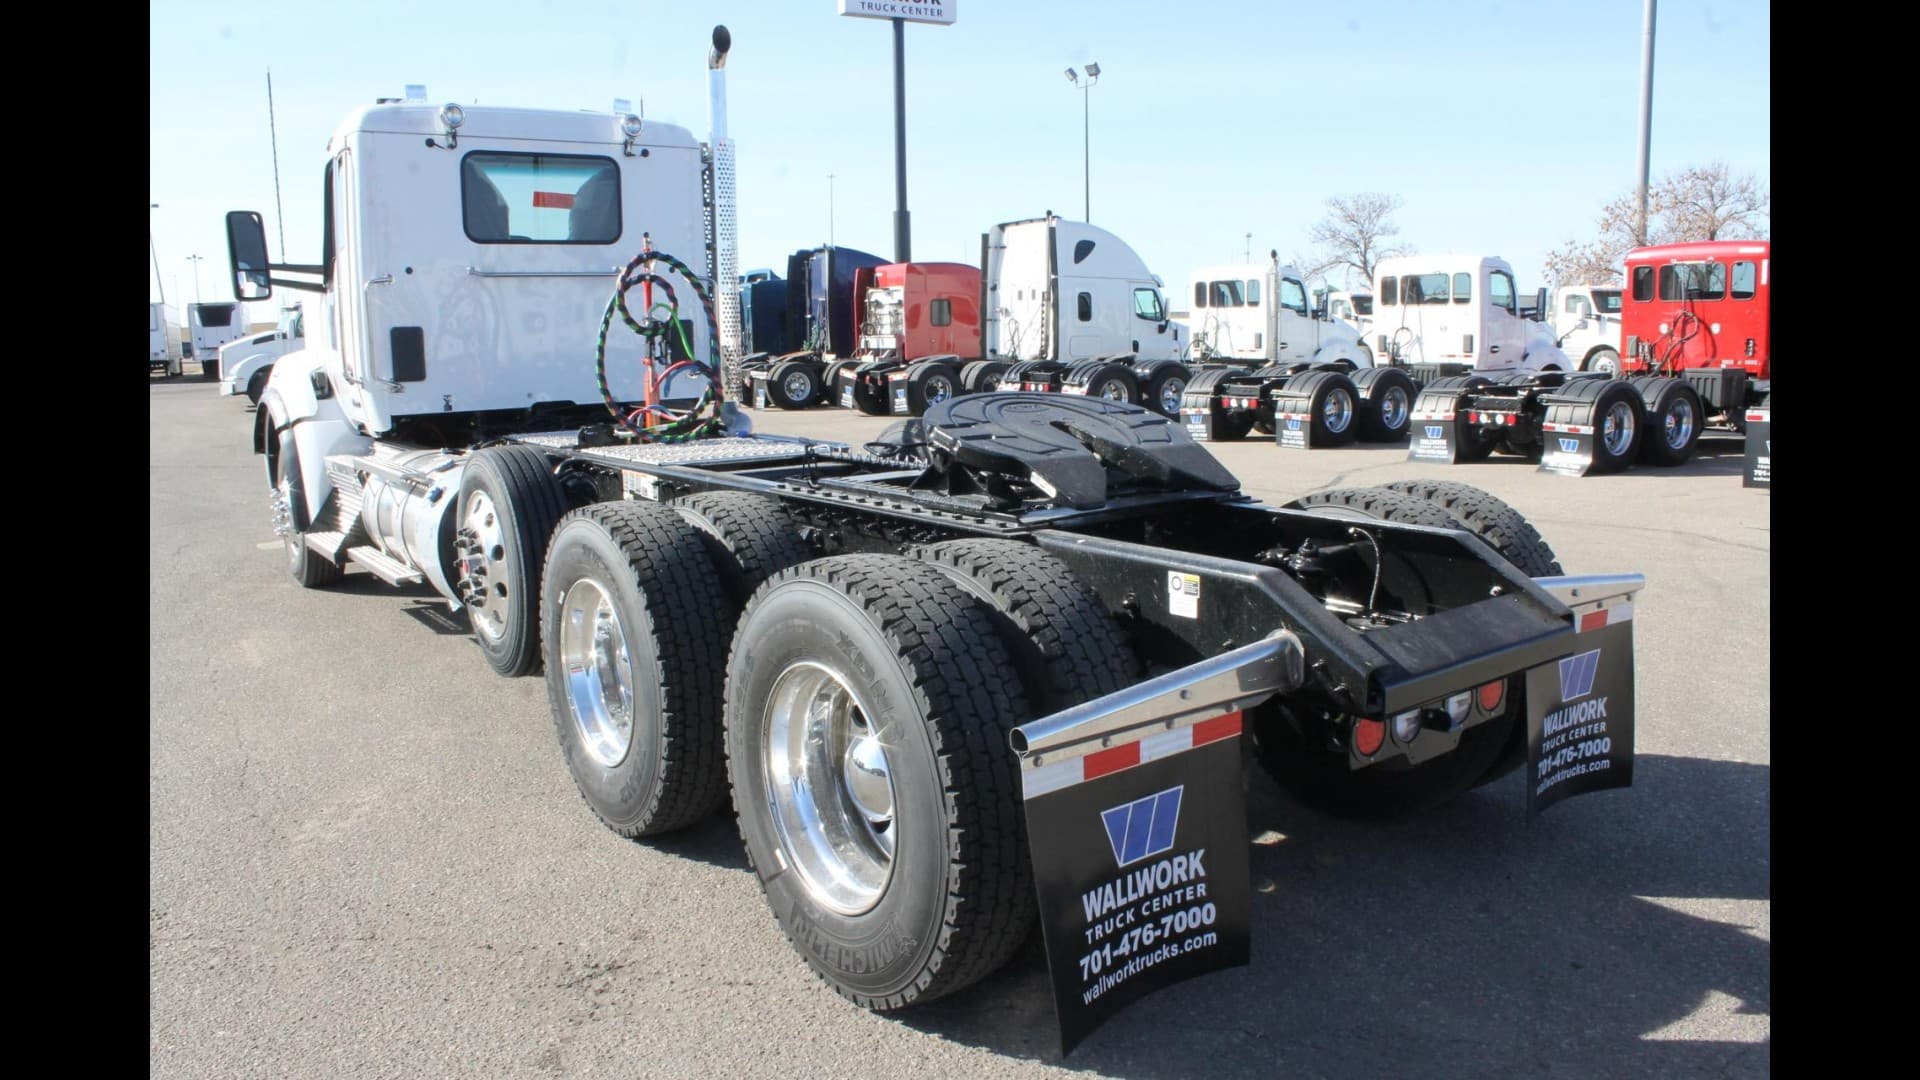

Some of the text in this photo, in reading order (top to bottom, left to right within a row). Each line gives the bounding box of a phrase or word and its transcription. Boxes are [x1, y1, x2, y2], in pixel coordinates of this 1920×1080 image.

[860, 2, 897, 13] TRUCK
[901, 6, 943, 17] CENTER
[1542, 722, 1607, 753] TRUCK CENTER
[1544, 697, 1608, 738] WALLWORK
[1538, 737, 1611, 779] 701-476-7000
[1082, 849, 1206, 922] WALLWORK
[1085, 883, 1208, 945] TRUCK CENTER
[1080, 903, 1217, 981] 701-476-7000
[1083, 931, 1217, 1006] wallworktrucks.com
